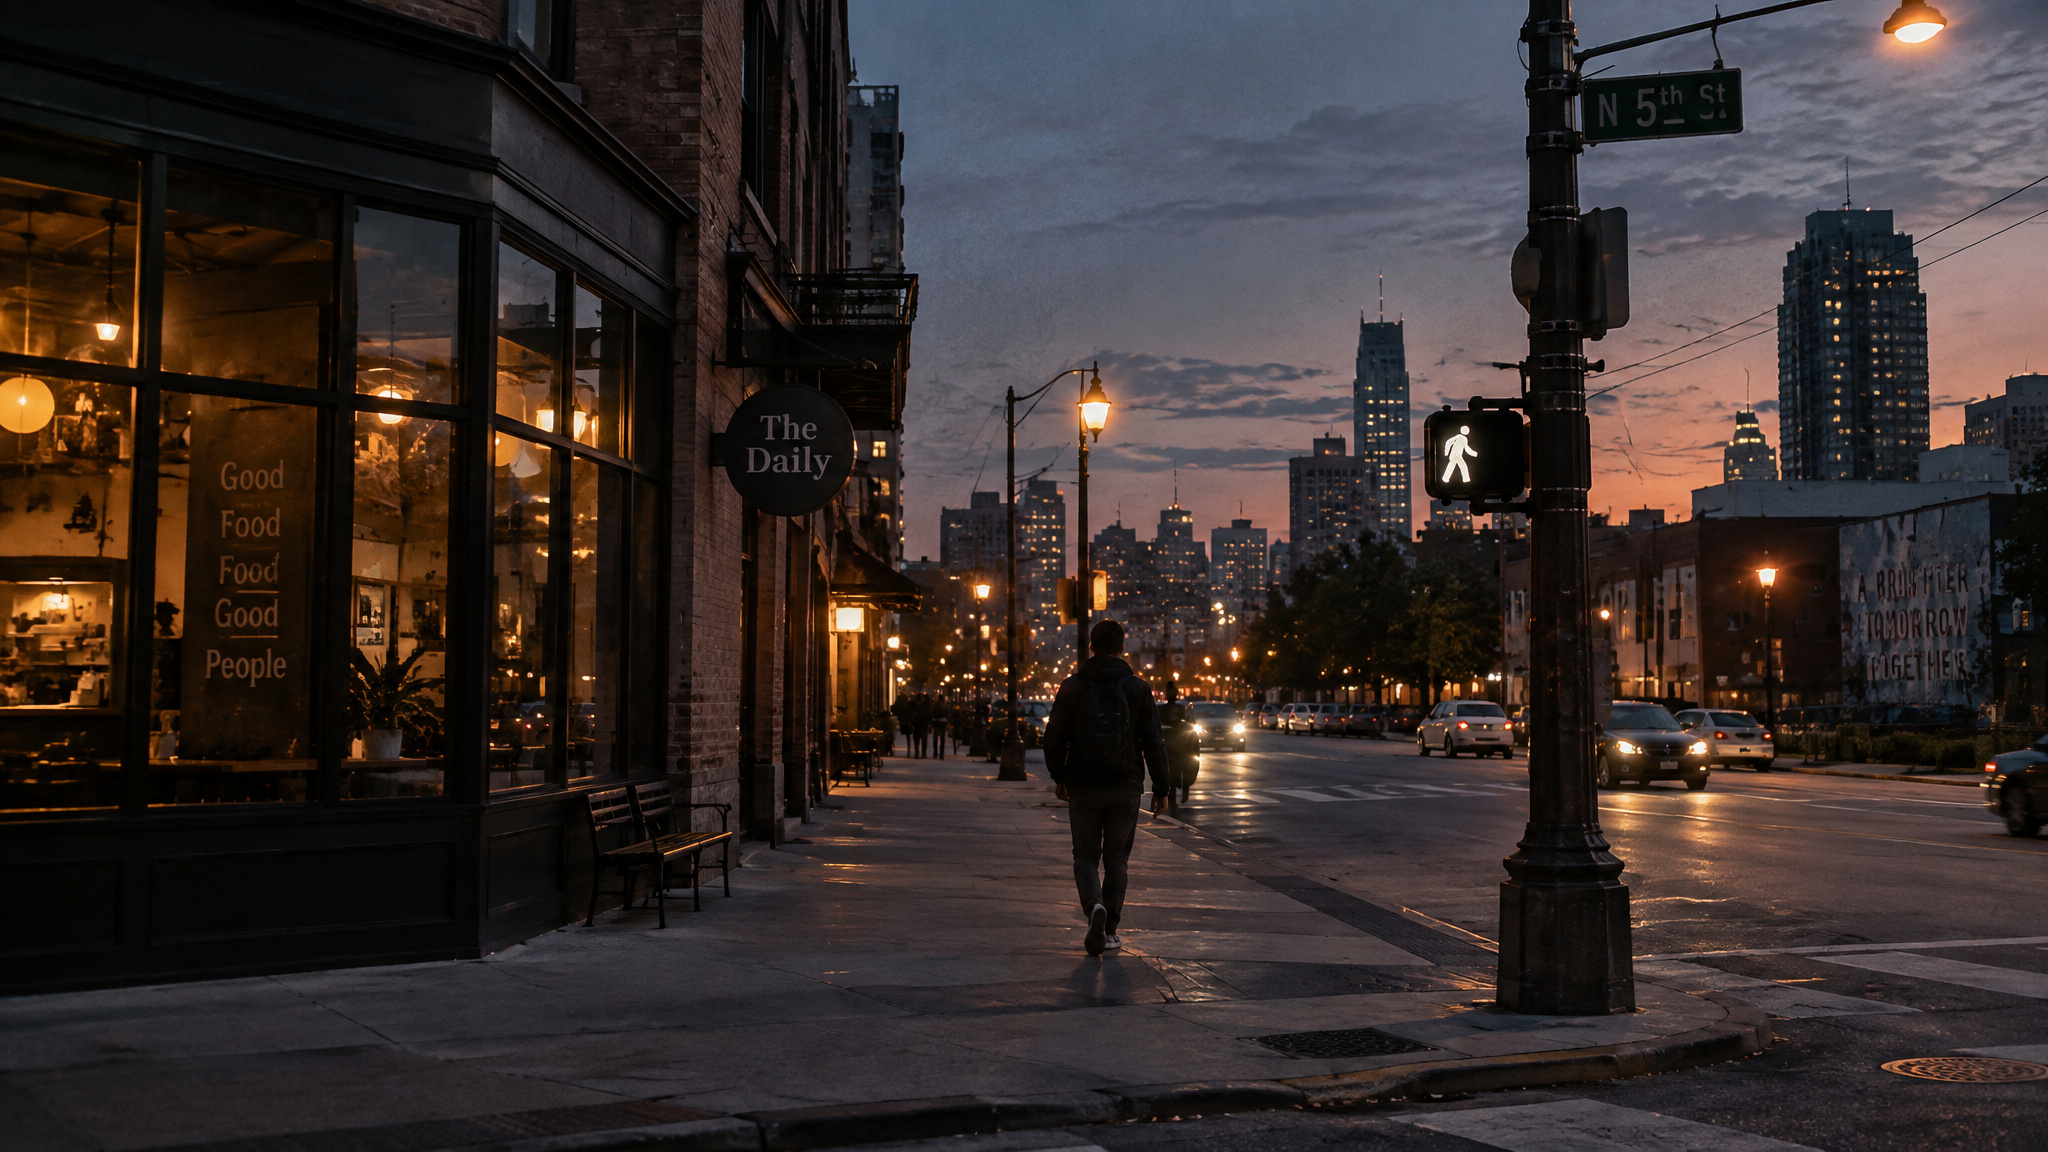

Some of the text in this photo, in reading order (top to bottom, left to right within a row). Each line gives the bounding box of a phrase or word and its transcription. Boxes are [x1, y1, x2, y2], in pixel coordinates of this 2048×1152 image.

[1598, 92, 1618, 127] N
[1636, 84, 1685, 128] 5th
[760, 413, 818, 441] The
[220, 459, 284, 492] Good
[745, 445, 833, 481] Daily
[220, 506, 281, 539] Food
[219, 551, 281, 585] Food
[1857, 569, 1868, 603] A
[214, 597, 279, 628] Good
[1865, 605, 1969, 643] TOMORROW
[205, 647, 287, 688] People
[1866, 648, 1970, 682] TOGETHER
